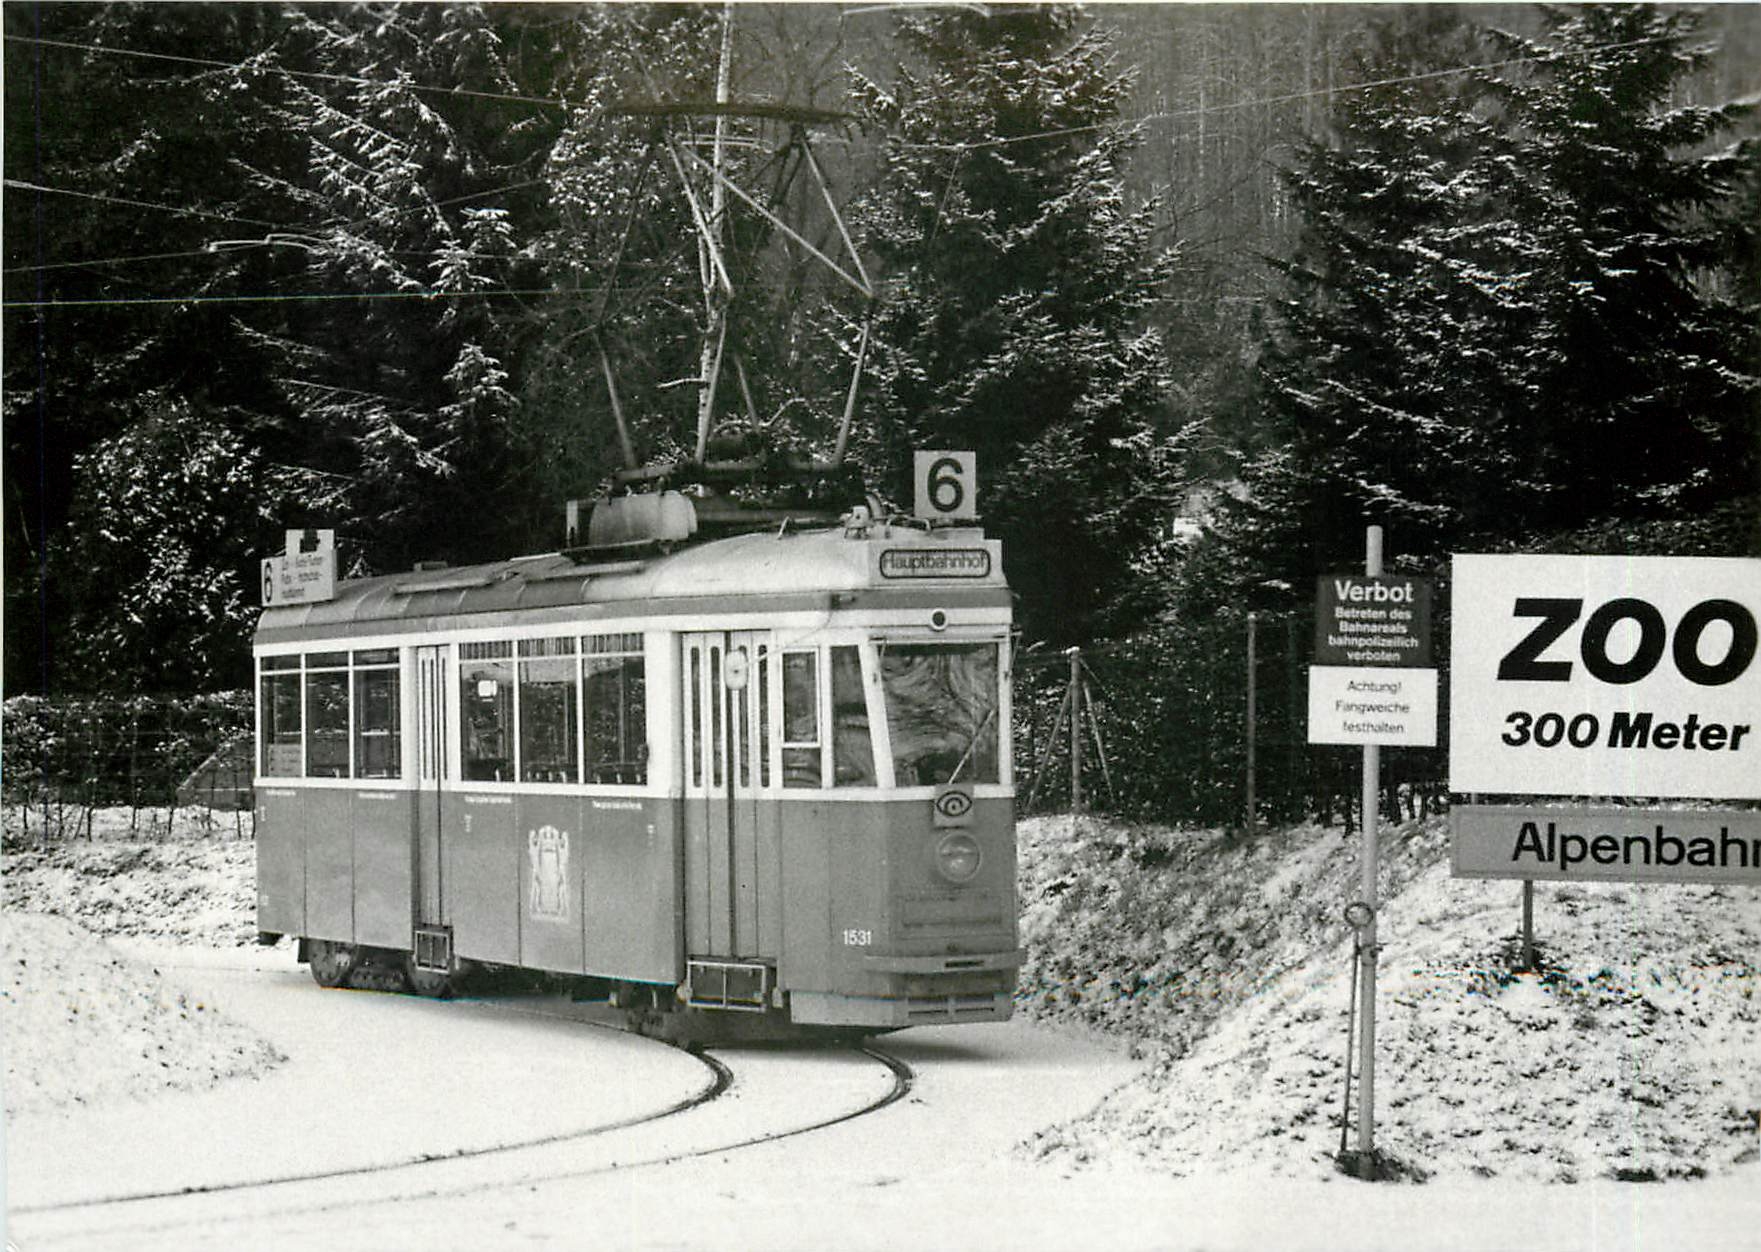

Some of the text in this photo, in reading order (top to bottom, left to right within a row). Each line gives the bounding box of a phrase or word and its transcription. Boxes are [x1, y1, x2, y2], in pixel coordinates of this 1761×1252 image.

[927, 457, 964, 513] 6
[264, 561, 272, 603] 6
[1334, 579, 1415, 603] Verbot
[1334, 606, 1413, 620] Betreten des
[1339, 620, 1408, 634] Bahnareals
[1328, 634, 1419, 648] bahnpolizeilich
[1346, 650, 1401, 662] verboten
[1347, 680, 1402, 695] Achtung!
[1335, 699, 1410, 714] Fangweiche
[1501, 711, 1751, 751] 300 Meter
[843, 929, 872, 946] 1531
